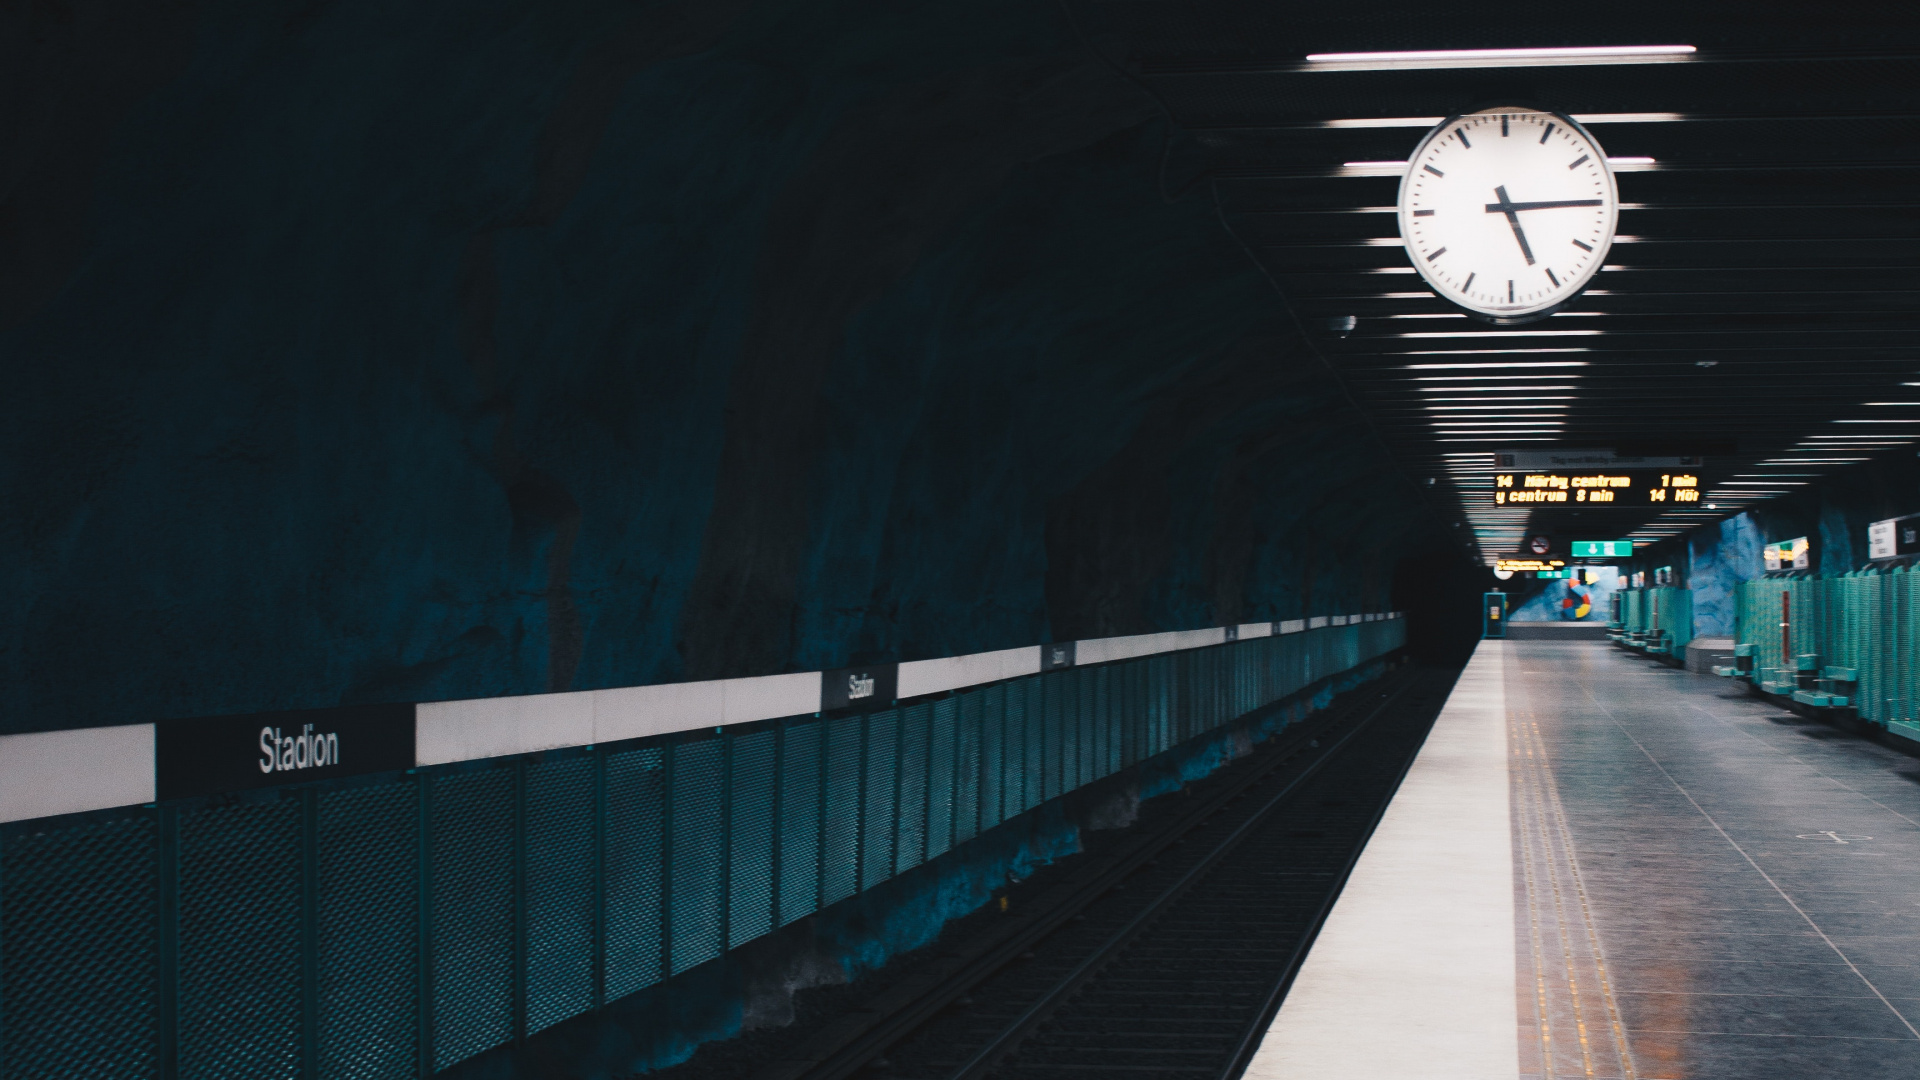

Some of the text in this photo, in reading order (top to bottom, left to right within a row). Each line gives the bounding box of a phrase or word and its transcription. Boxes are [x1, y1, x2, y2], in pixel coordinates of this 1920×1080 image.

[1496, 474, 1514, 488] 14
[1571, 474, 1631, 488] centrum
[1662, 474, 1670, 488] 1
[1672, 474, 1698, 488] min
[1509, 489, 1568, 502] centrum
[1576, 489, 1587, 502] 8
[1590, 489, 1615, 502] min
[1650, 488, 1666, 502] 14
[259, 722, 339, 774] Stadion
